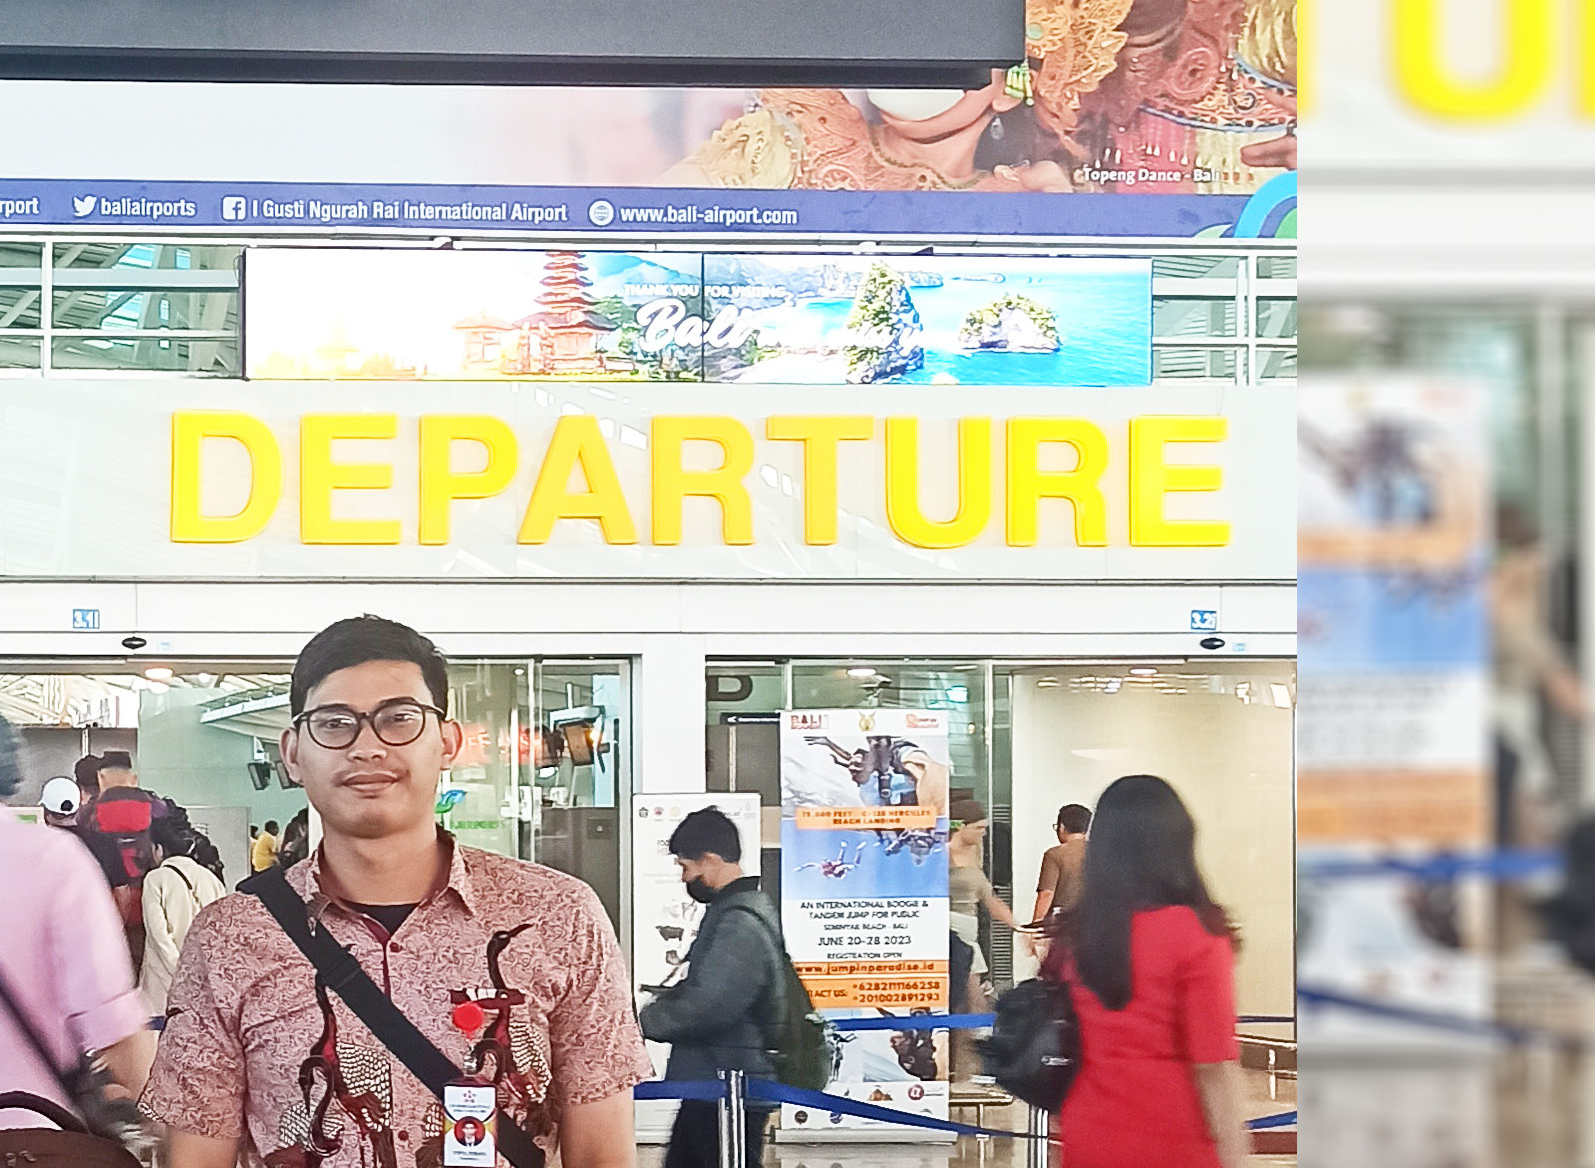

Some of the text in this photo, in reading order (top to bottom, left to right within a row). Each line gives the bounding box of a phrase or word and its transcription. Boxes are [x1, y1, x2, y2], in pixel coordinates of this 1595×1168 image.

[1083, 167, 1136, 185] Topeng
[1138, 168, 1181, 182] Dance
[1193, 168, 1219, 182] Bali
[100, 196, 196, 219] baliairports
[252, 200, 568, 224] I Gusti Ngurah Rai International Airport
[620, 205, 798, 226] www.bali-airport.com
[625, 284, 787, 299] THANK YOU FOR VISITING
[171, 409, 1232, 549] DEPARTURE
[800, 901, 814, 909] AN
[816, 901, 884, 909] INTERNATIONAL
[887, 900, 919, 908] BOOGIE
[809, 910, 920, 919] TANDEM JUMP FOR PUBLIC
[818, 935, 912, 946] JUNE 20-28 2023
